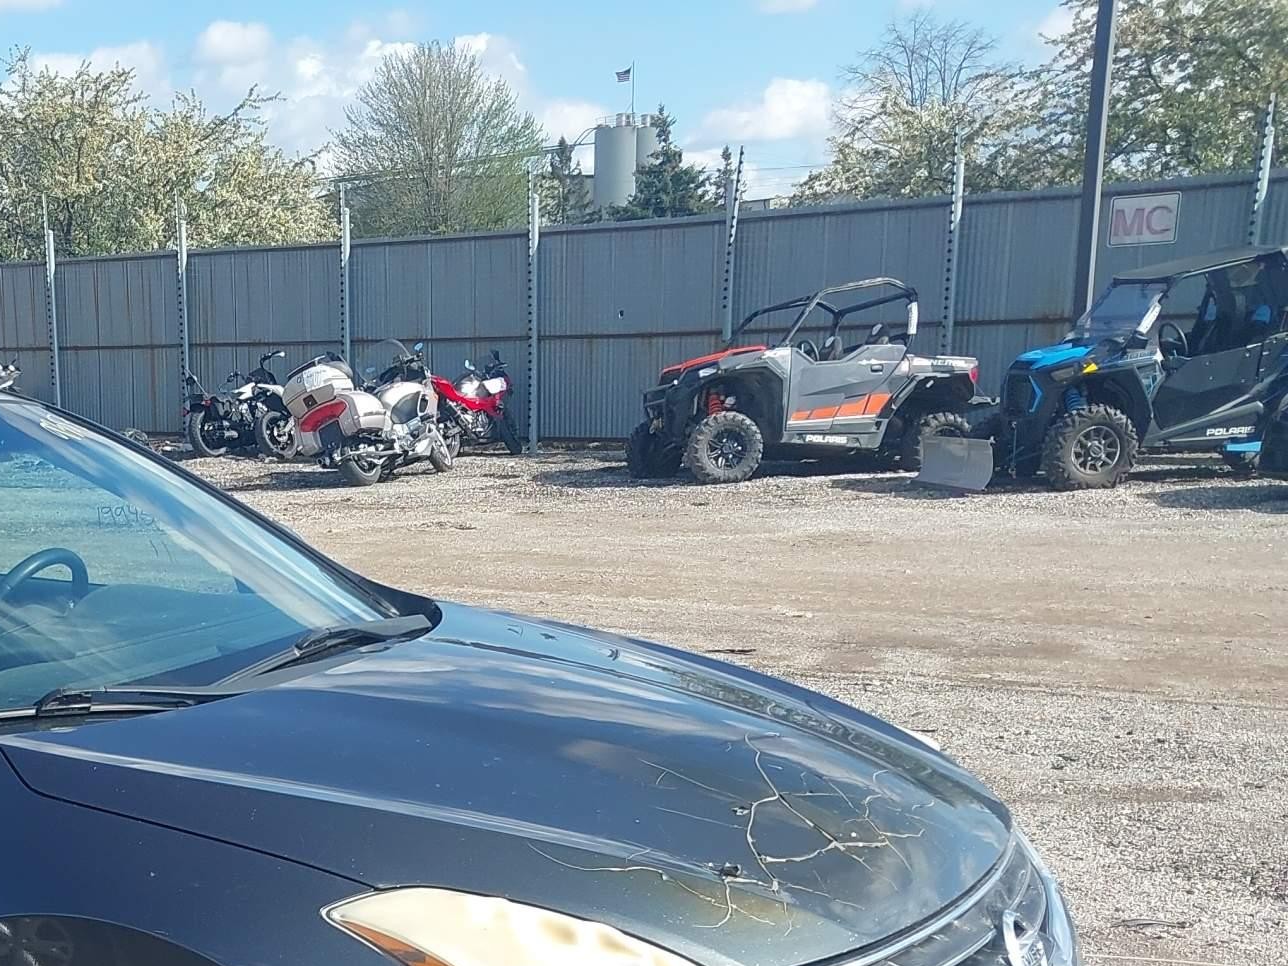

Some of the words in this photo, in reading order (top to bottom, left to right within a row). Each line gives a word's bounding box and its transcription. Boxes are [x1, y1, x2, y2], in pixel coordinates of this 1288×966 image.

[1112, 205, 1173, 237] MC
[1205, 426, 1257, 437] POLARIS
[805, 434, 848, 444] POLARIS
